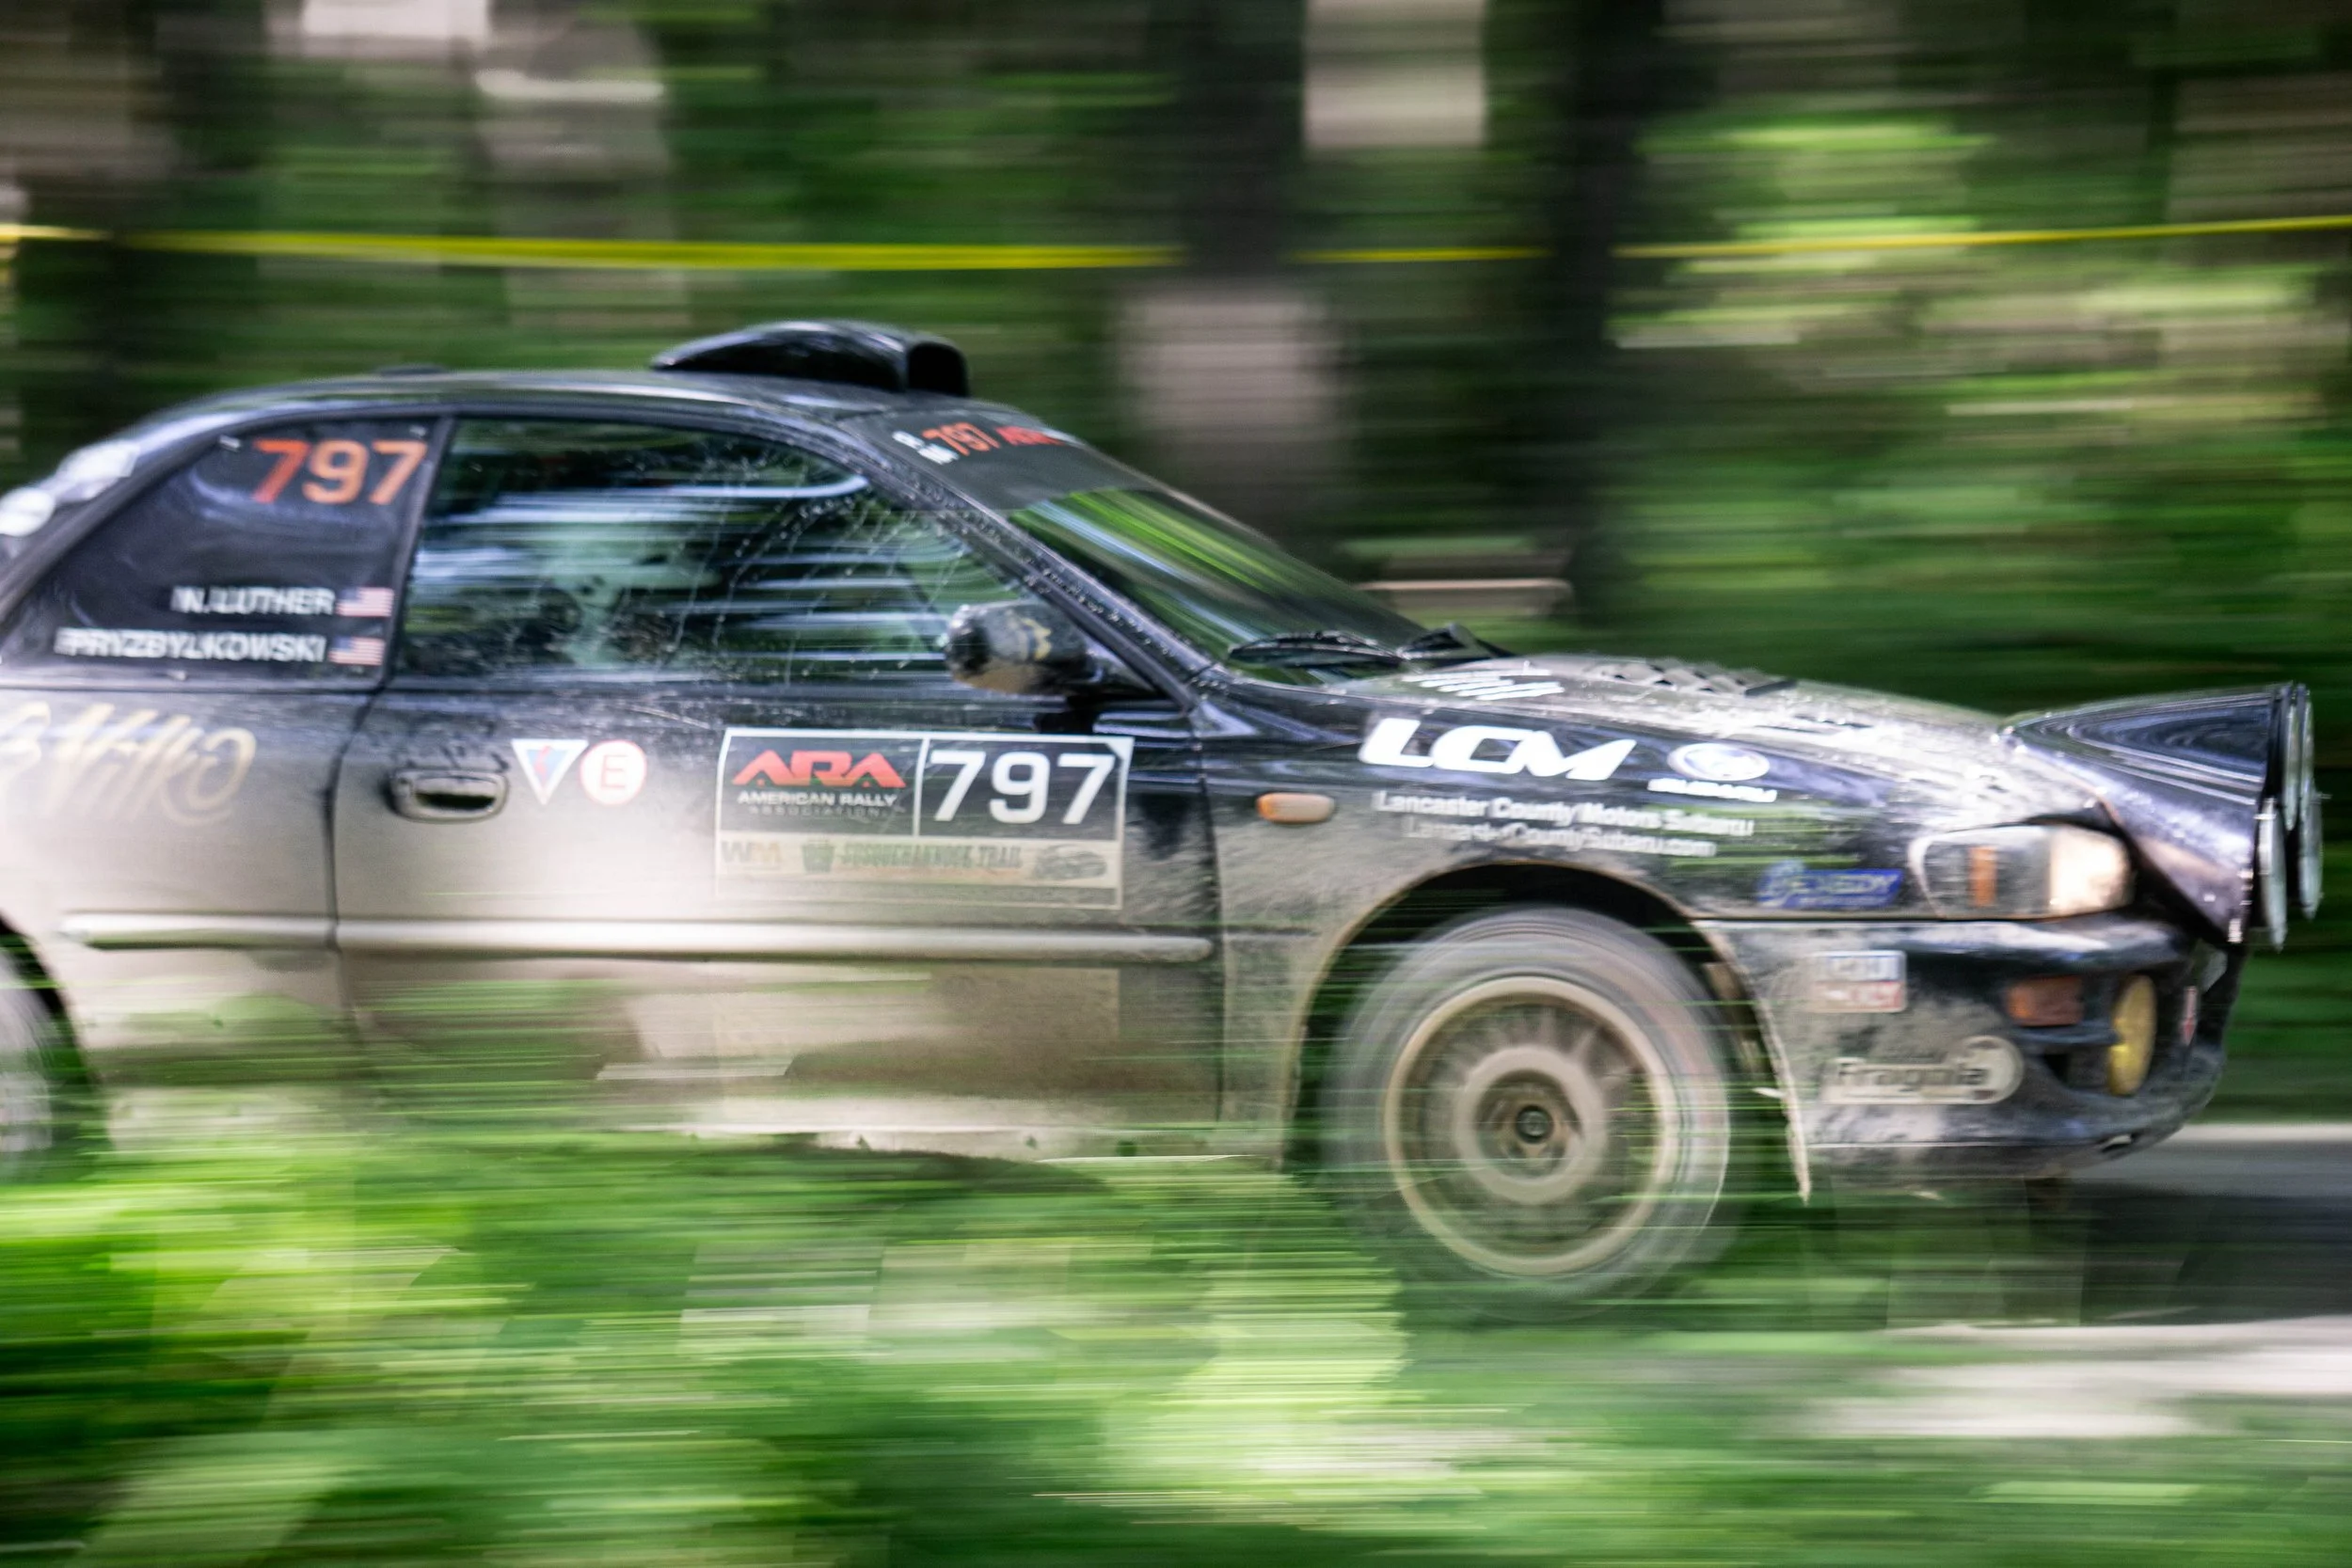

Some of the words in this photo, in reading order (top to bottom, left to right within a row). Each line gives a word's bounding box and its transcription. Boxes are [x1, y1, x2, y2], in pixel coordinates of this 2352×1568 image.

[253, 438, 427, 505] 797
[601, 754, 628, 789] E
[732, 750, 907, 788] ARA
[1357, 717, 1637, 781] LCM
[738, 790, 835, 806] AMERICAN
[839, 793, 898, 808] RALLY
[930, 750, 1117, 825] 797
[1371, 790, 1486, 817] Lancaster
[1486, 797, 1574, 827] County
[1573, 802, 1661, 830] Motors
[1662, 808, 1756, 836] Subaru
